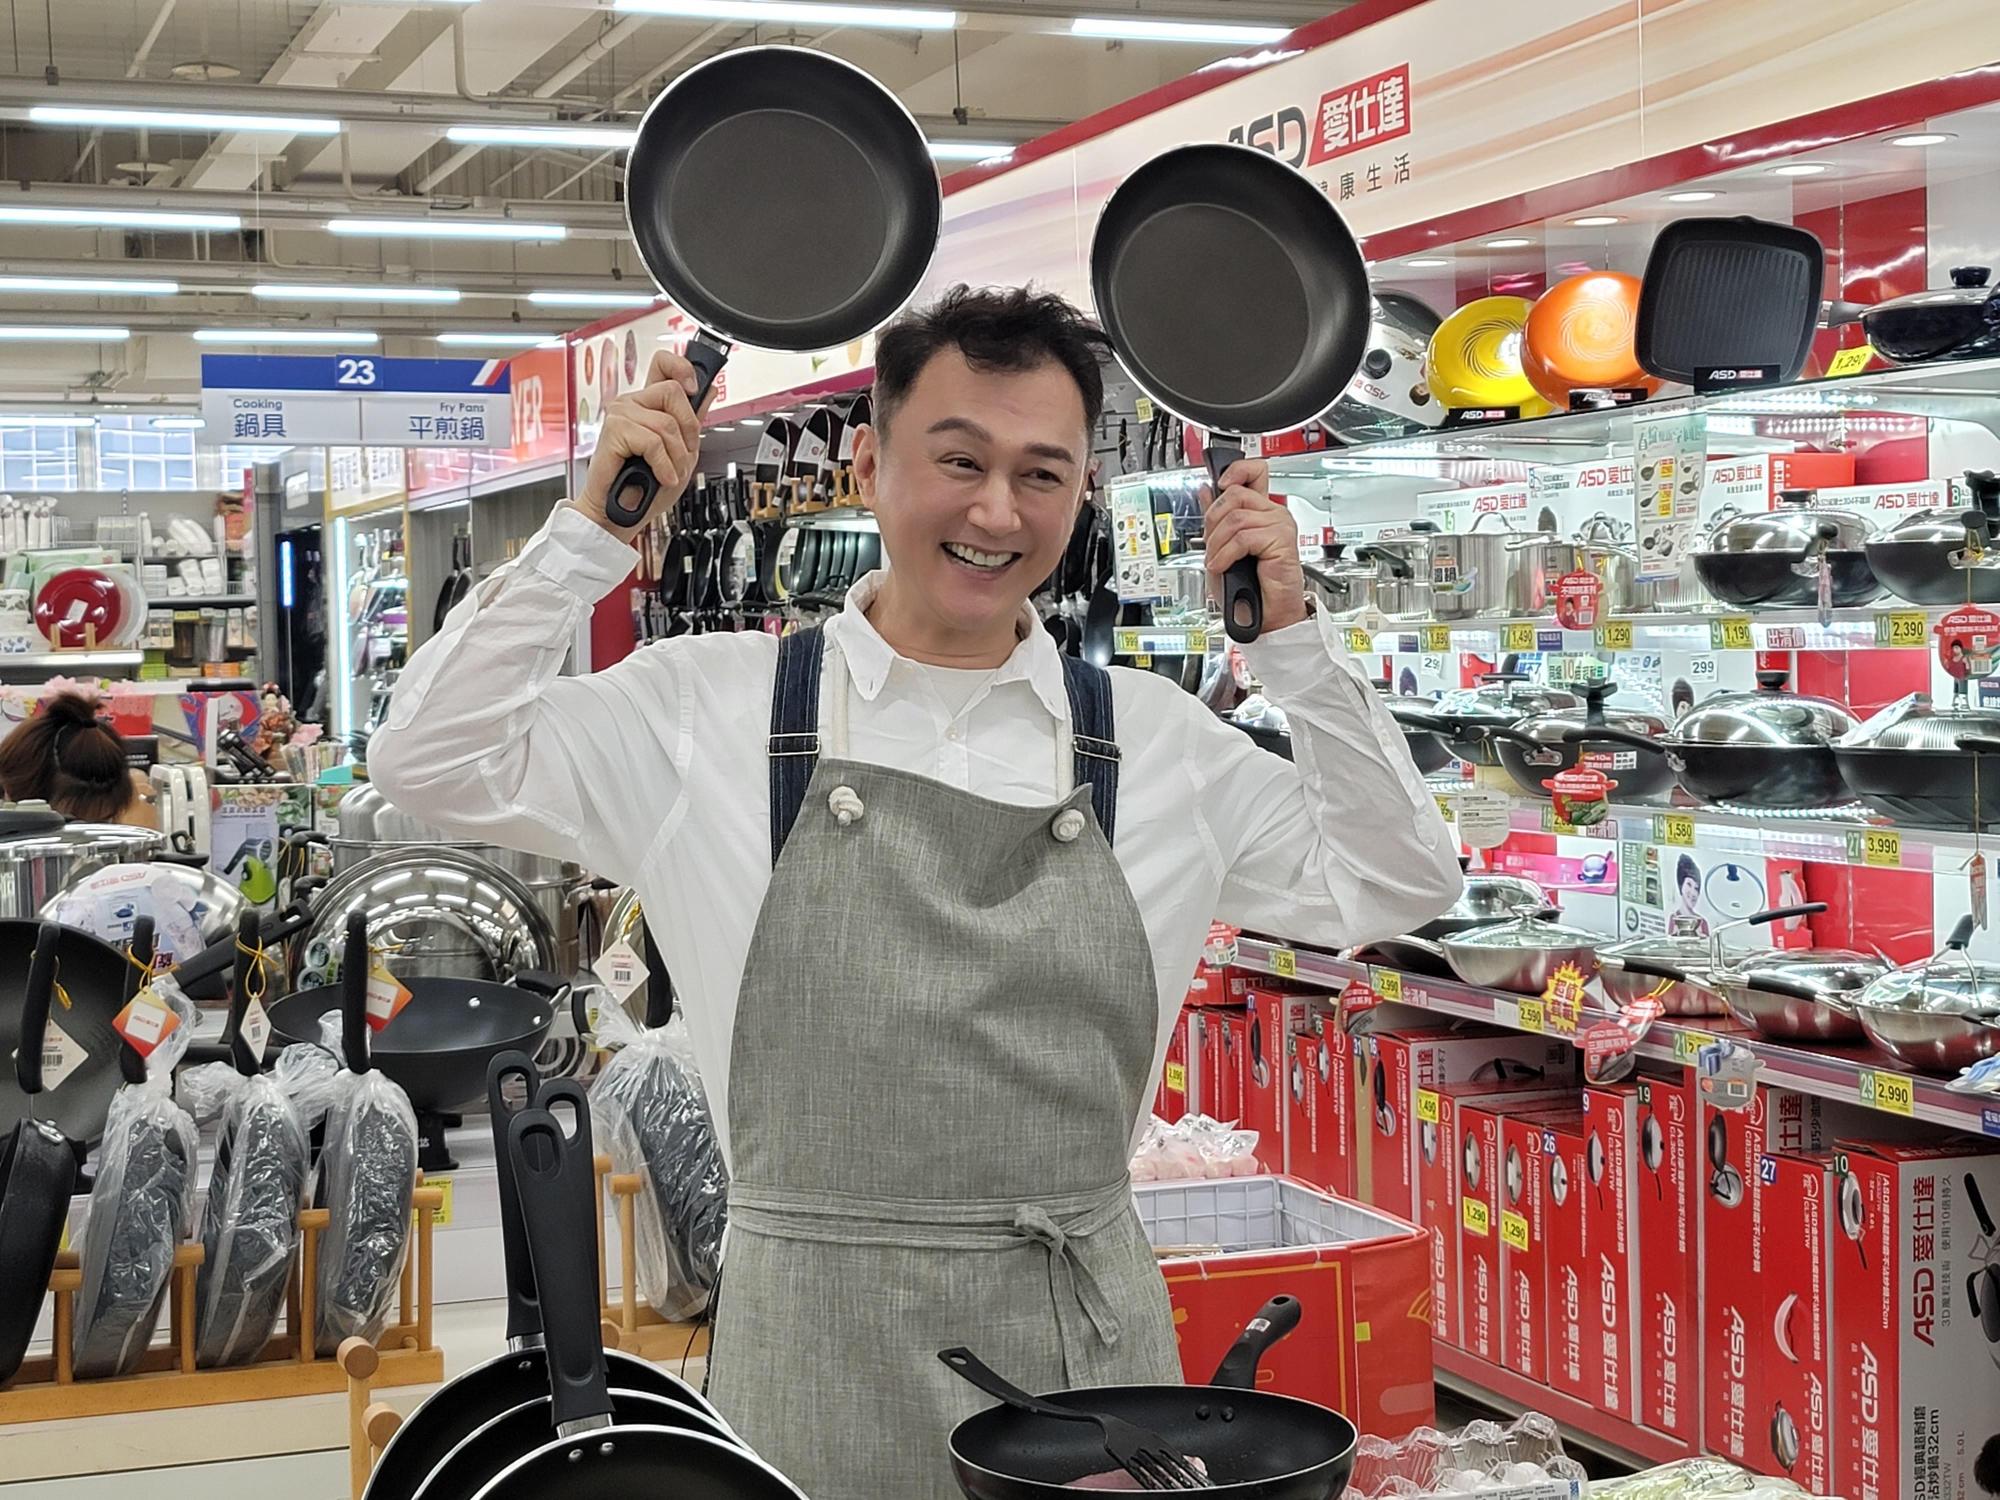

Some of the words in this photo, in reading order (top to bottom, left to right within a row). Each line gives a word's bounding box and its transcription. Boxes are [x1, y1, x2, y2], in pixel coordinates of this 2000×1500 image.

[1322, 76, 1406, 153] 愛仕達
[339, 359, 376, 385] 23
[1709, 370, 1737, 380] ASD
[233, 398, 282, 411] Cooking
[440, 403, 457, 414] Fry
[459, 403, 485, 413] Pans
[233, 412, 287, 438] 鍋具
[1460, 411, 1484, 420] ASD
[409, 415, 485, 441] 平煎鍋
[1577, 469, 1606, 488] ASD
[1712, 467, 1736, 485] ASD
[1472, 496, 1499, 513] ASD
[1874, 493, 1905, 509] ASD
[1512, 629, 1533, 645] 1,490
[1607, 628, 1631, 645] 1,290
[1724, 624, 1750, 641] 1,190
[1876, 615, 1889, 640] 10
[1893, 620, 1924, 638] 2,390
[1353, 634, 1371, 646] 790
[1692, 660, 1714, 674] 299
[1667, 822, 1692, 838] 1,580
[1868, 838, 1898, 855] 3,990
[1520, 1007, 1542, 1025] 2,590
[1353, 1041, 1362, 1055] 31
[1638, 1086, 1651, 1102] 19
[1861, 1072, 1875, 1099] 29
[1877, 1083, 1909, 1104] 2,990
[1583, 1093, 1590, 1112] 9
[1543, 1133, 1556, 1153] 26
[1761, 1160, 1776, 1180] 27
[1834, 1155, 1849, 1172] 10
[1504, 1220, 1526, 1240] 1,290
[1433, 1224, 1445, 1279] ASD
[1478, 1254, 1488, 1303] ASD
[1519, 1269, 1530, 1320] ASD
[1566, 1264, 1578, 1321] ASD
[1600, 1251, 1617, 1328] ASD
[1913, 1267, 1935, 1348] ASD
[1663, 1291, 1676, 1358] ASD
[1731, 1305, 1745, 1379] ASD
[1861, 1341, 1878, 1424] ASD
[1810, 1371, 1823, 1431] ASD
